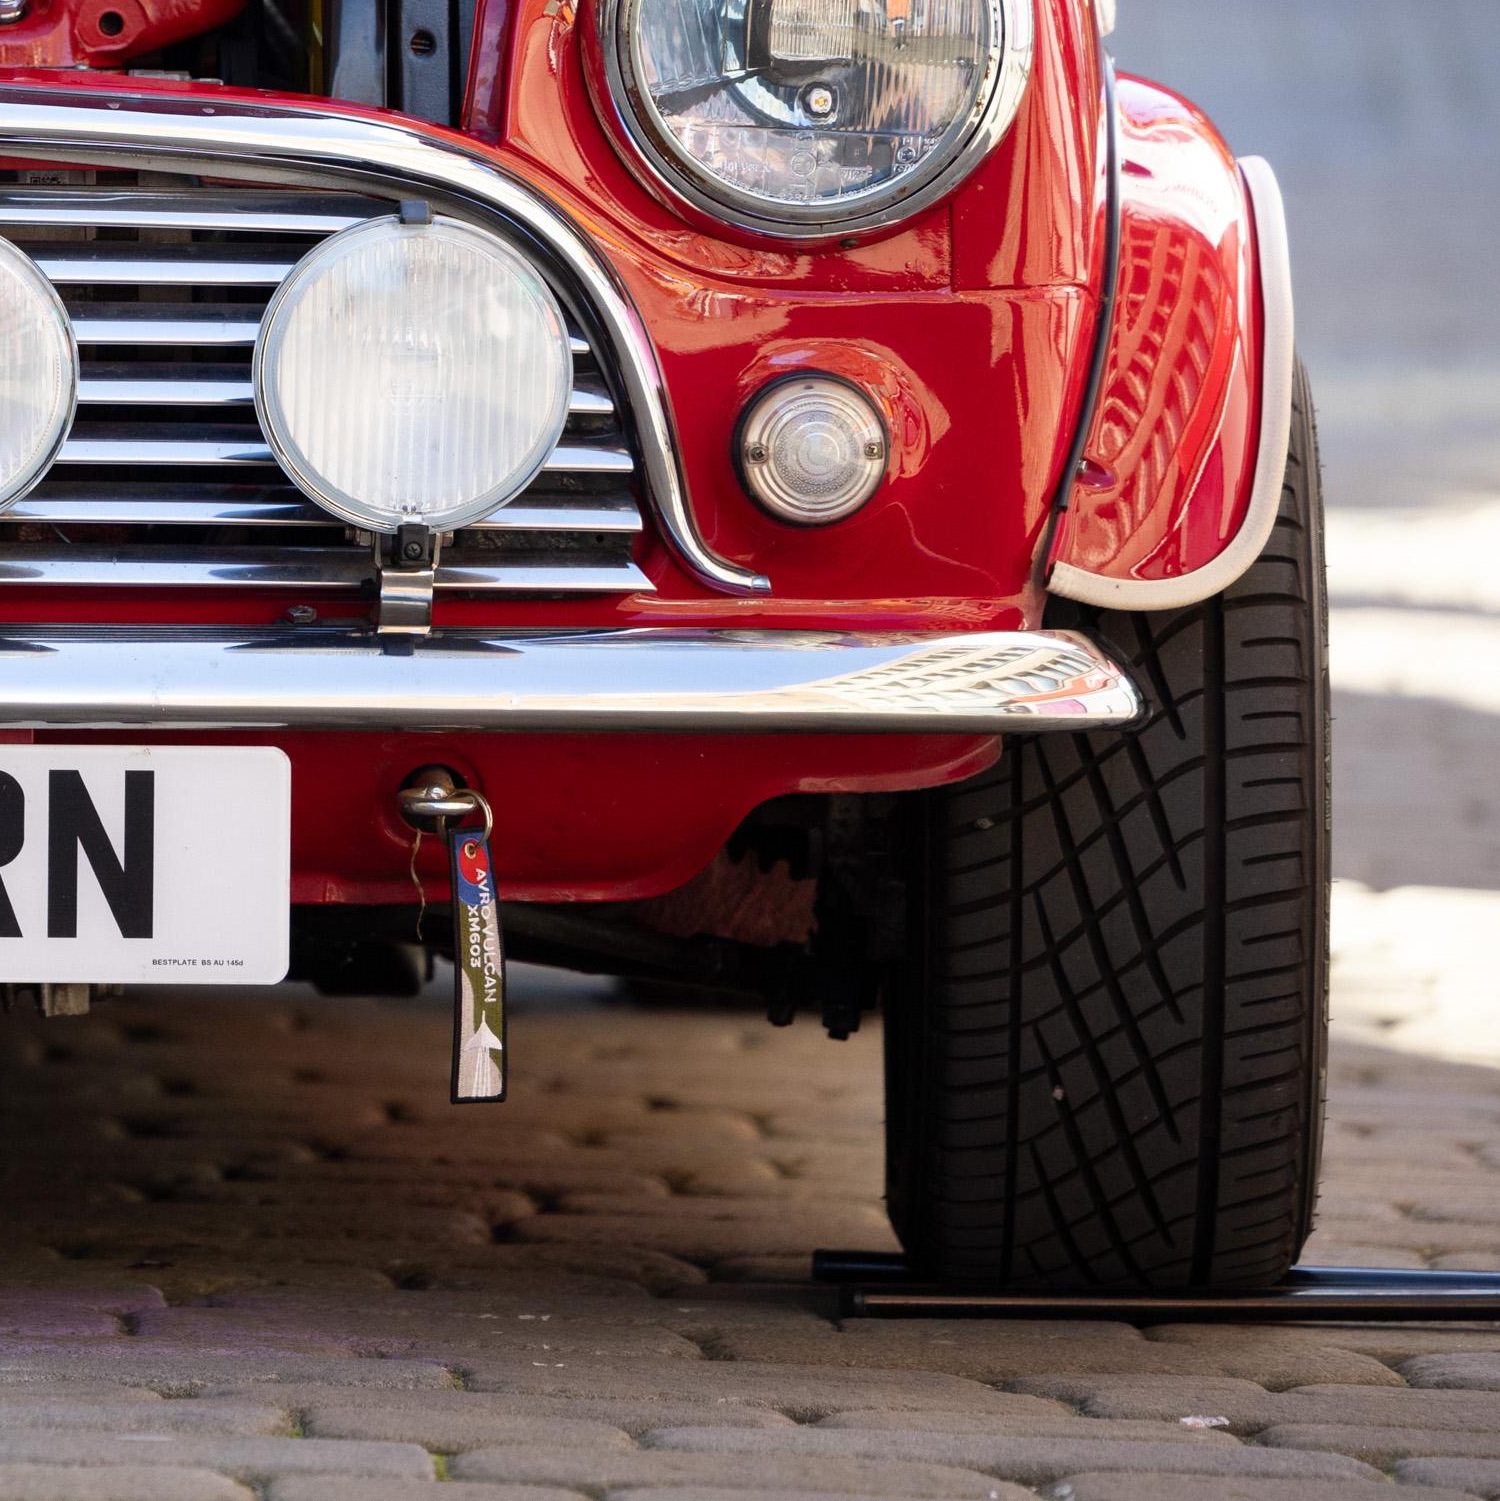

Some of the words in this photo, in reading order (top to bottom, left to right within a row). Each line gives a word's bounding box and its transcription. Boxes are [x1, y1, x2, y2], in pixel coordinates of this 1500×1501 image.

[476, 868, 491, 920] AVRO
[151, 958, 198, 967] BESTPLATE
[201, 959, 212, 967] BS
[213, 959, 226, 967] AU
[226, 959, 244, 967] 145d
[467, 904, 481, 968] XM603
[482, 923, 497, 1003] VULCAN
